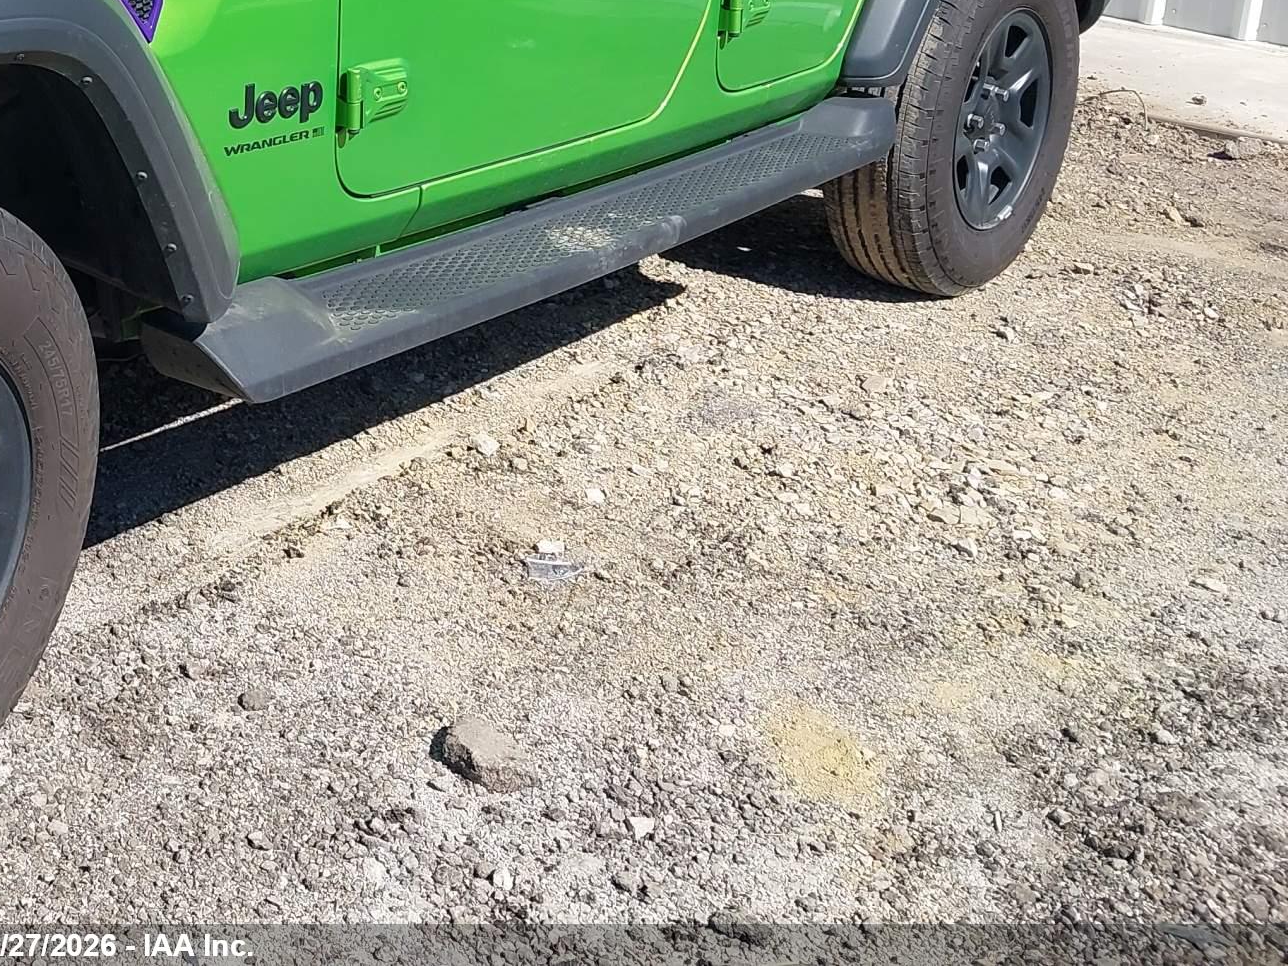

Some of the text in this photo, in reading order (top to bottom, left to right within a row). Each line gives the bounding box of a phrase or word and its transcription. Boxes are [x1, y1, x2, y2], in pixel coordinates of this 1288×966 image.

[228, 81, 323, 129] Jeep
[224, 130, 309, 157] WRANGLER
[37, 339, 73, 418] 245/75R17
